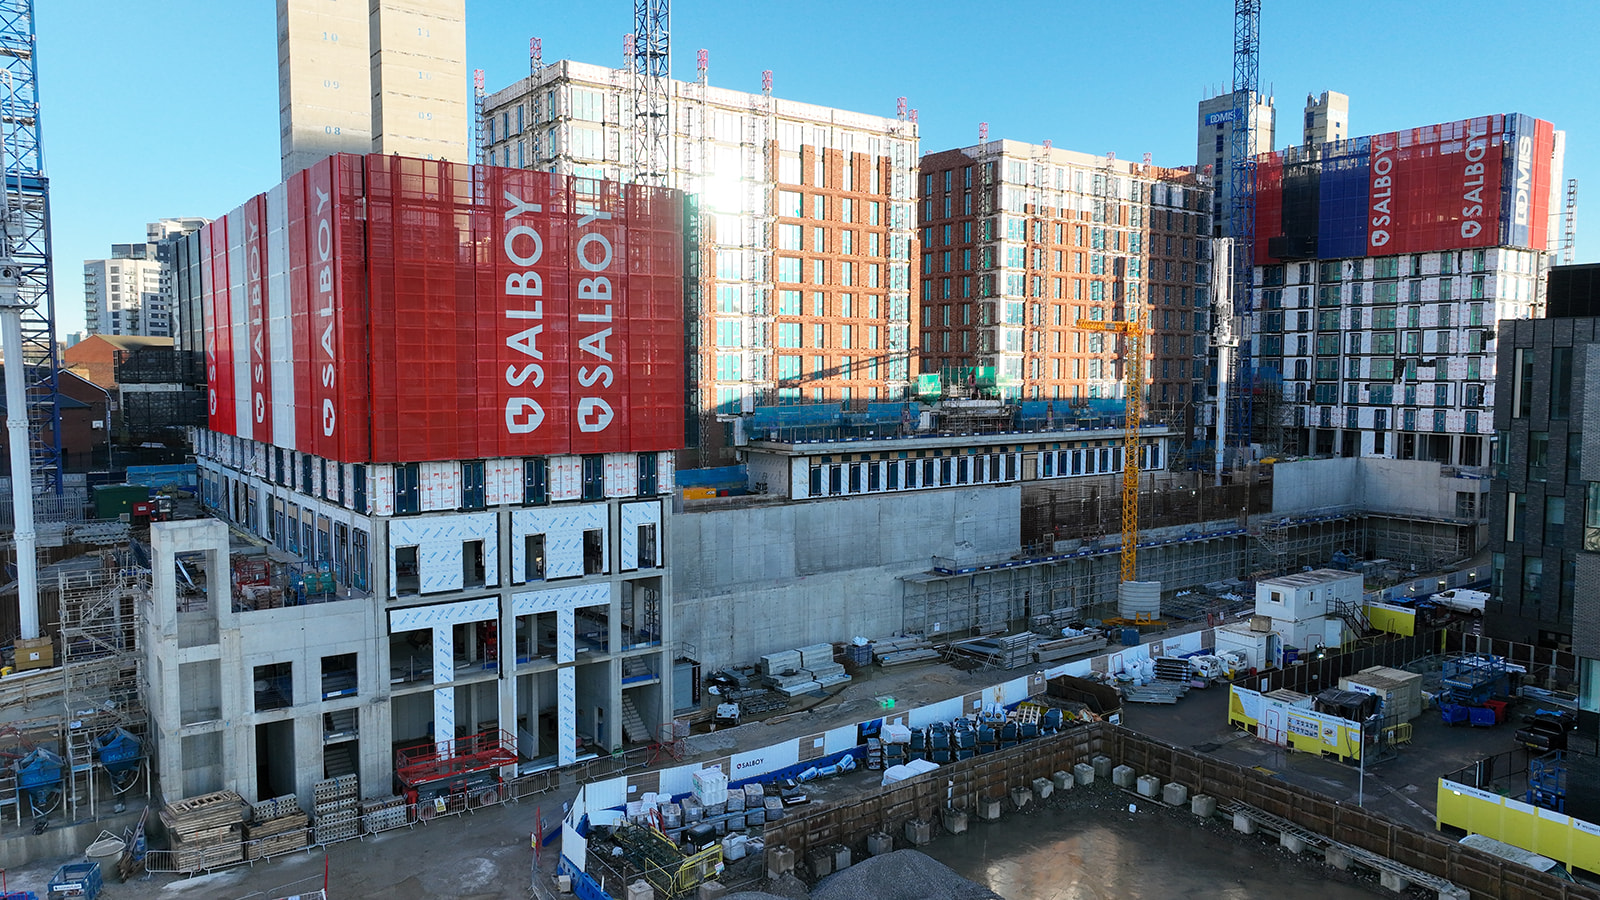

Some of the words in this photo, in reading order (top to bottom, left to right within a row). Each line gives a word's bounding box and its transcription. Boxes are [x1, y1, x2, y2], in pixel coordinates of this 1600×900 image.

[322, 31, 338, 42] 10
[417, 27, 431, 38] 11
[323, 79, 340, 90] 09
[418, 111, 433, 121] 09
[325, 125, 341, 136] 08
[1462, 129, 1487, 217] SALBOY
[1372, 144, 1394, 226] SALBOY
[1514, 135, 1532, 225] DOMIS
[204, 243, 216, 382] SALBOY
[248, 219, 265, 386] SALBOY
[317, 187, 336, 389] SALBOY
[504, 190, 544, 388] SALBOY
[577, 209, 614, 389] SALBOY
[742, 758, 764, 769] SALBOY
